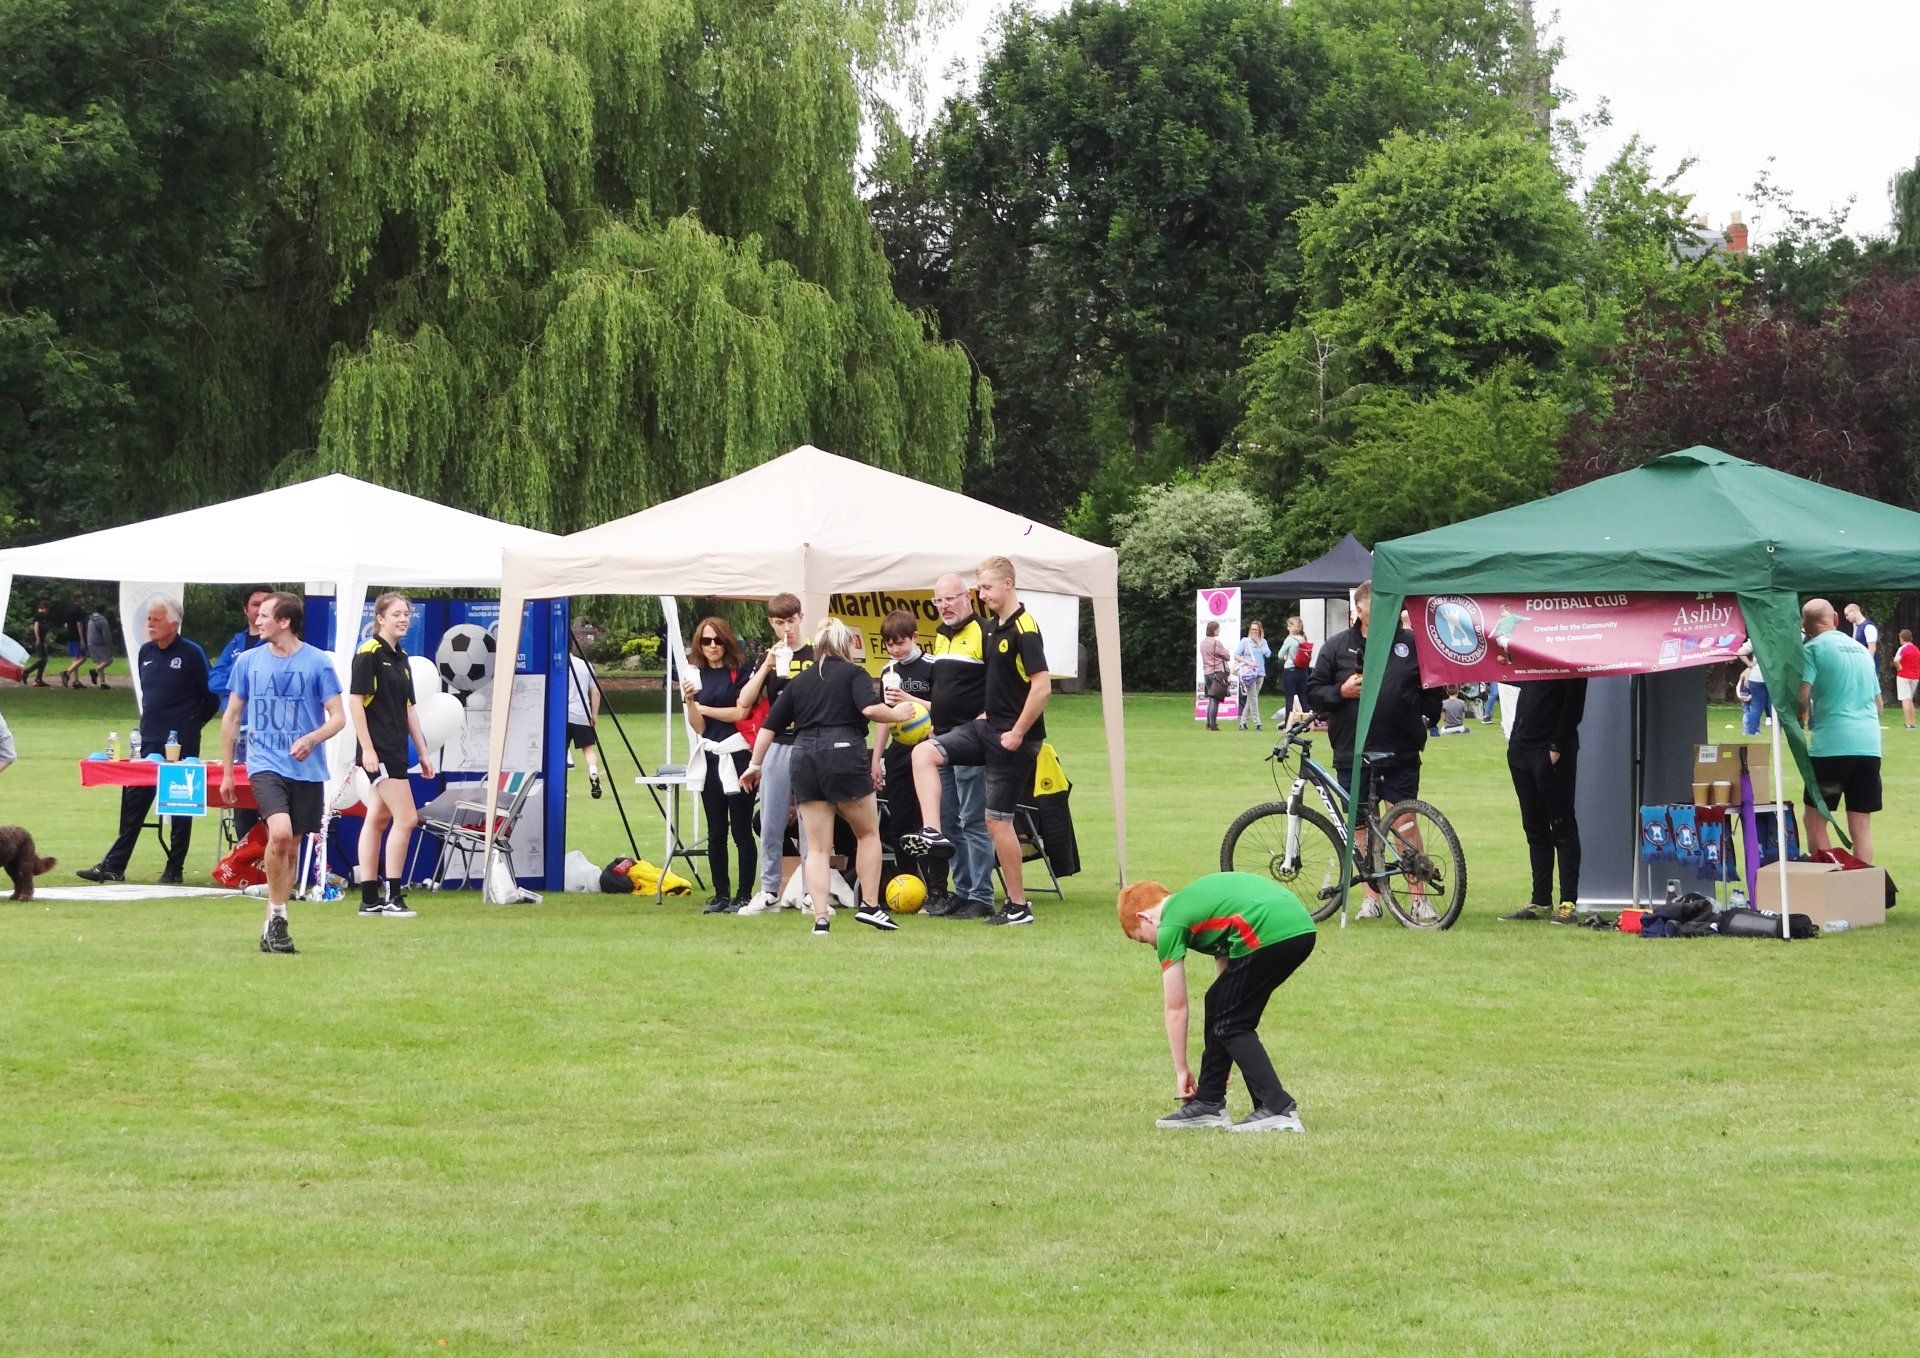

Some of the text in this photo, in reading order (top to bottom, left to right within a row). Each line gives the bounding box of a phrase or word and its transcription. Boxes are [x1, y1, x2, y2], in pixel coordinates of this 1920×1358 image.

[829, 589, 995, 621] Marlboroh
[1429, 596, 1477, 615] ASHBY UNITED
[1526, 594, 1628, 611] FOOTBALL CLUB
[1673, 602, 1733, 627] Ashby
[1533, 621, 1618, 632] Created for the Community
[1429, 624, 1461, 660] COMMUNITY
[1462, 644, 1485, 662] FOOTBALL
[1546, 633, 1603, 643] By the Community
[253, 671, 309, 697] LAZY
[900, 678, 930, 692] idas
[254, 698, 306, 731] BUT
